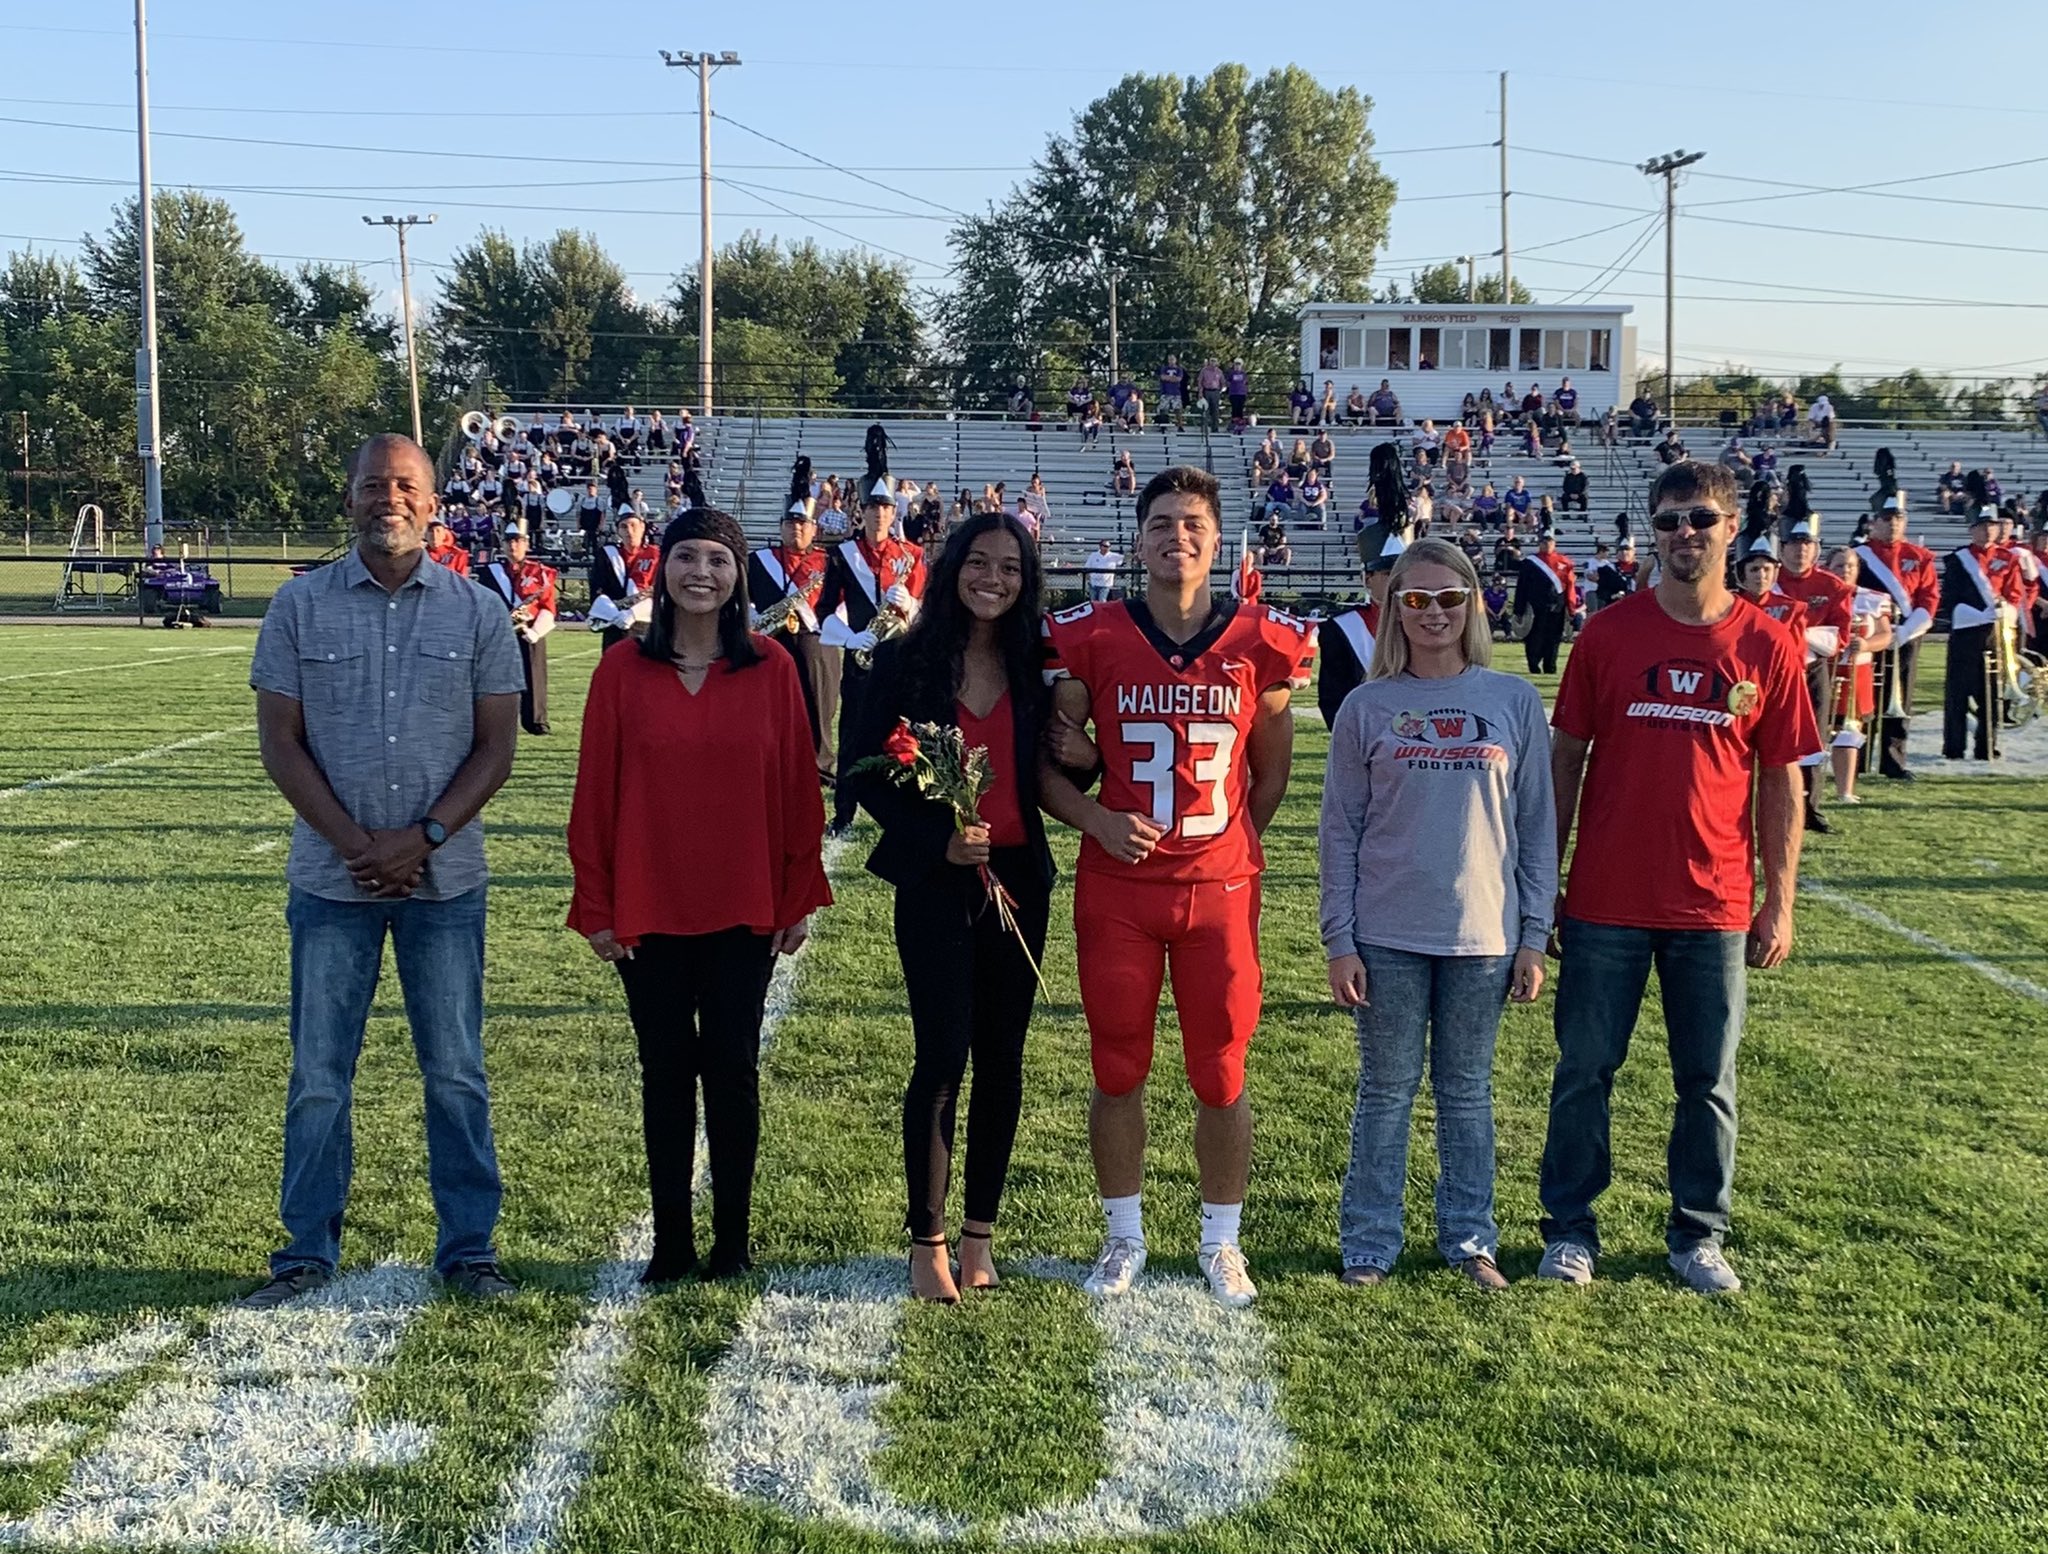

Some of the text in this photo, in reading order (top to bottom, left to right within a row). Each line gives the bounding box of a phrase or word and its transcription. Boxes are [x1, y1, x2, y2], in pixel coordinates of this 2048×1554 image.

[1449, 313, 1477, 323] FIELD
[1667, 668, 1704, 695] W
[1116, 684, 1242, 716] WAUSEON
[1430, 716, 1467, 740] W
[1408, 759, 1495, 771] FOOTBALL
[1120, 721, 1239, 839] 33
